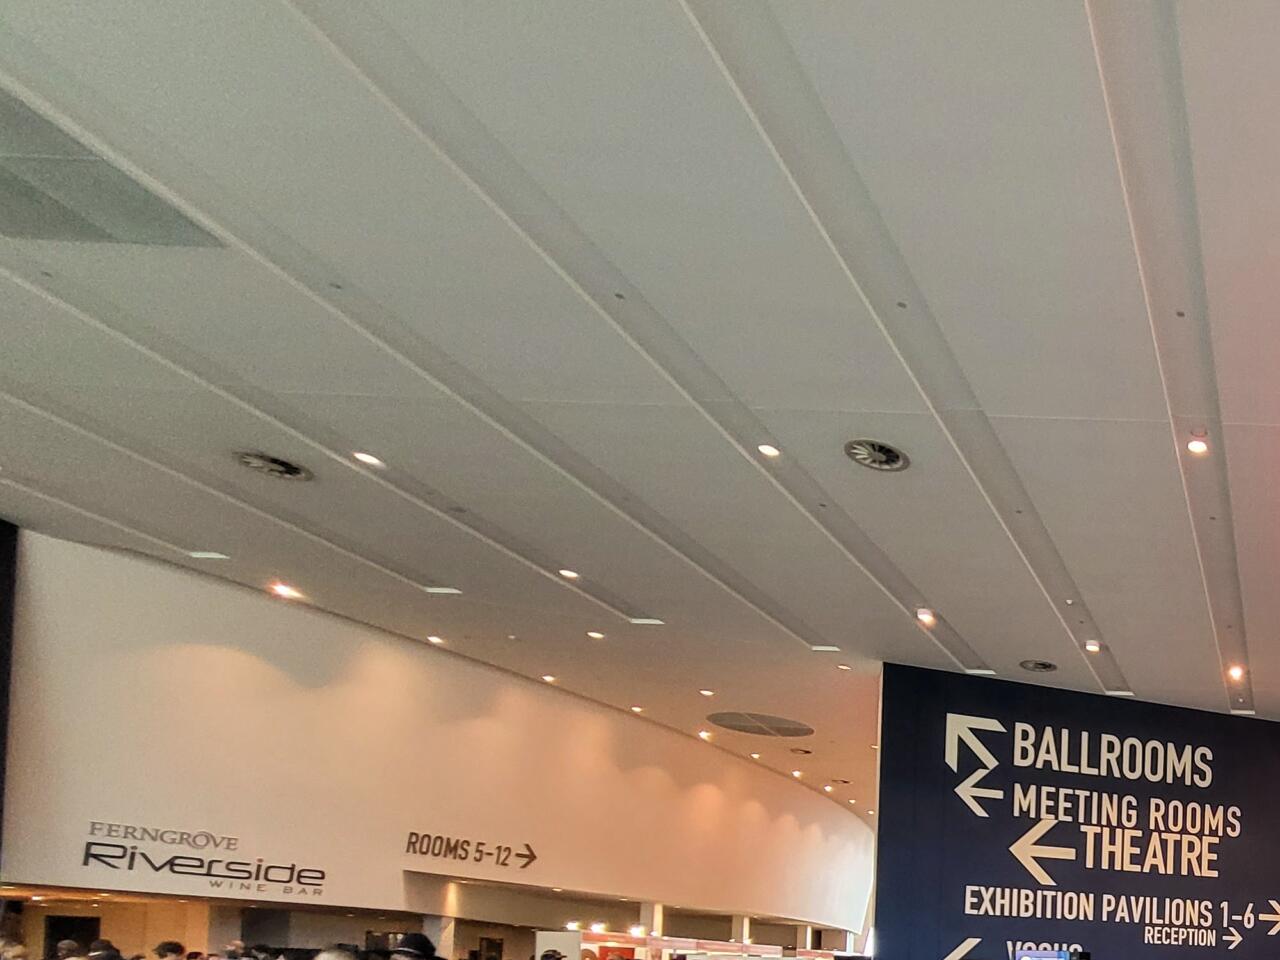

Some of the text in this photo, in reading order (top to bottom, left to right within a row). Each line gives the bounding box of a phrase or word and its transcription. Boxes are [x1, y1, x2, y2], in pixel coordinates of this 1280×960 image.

[1013, 722, 1214, 788] BALLROOMS
[1013, 783, 1242, 838] MEETING ROOMS
[89, 821, 239, 850] FERNGROVE
[406, 832, 512, 866] ROOMS 5-12
[1080, 825, 1220, 878] THEATRE
[82, 841, 326, 887] Riverside
[209, 880, 324, 896] WINE BAR
[964, 885, 1255, 929] EXHIBITION PAVILIONS 1-6
[1144, 926, 1216, 947] RECEPTION
